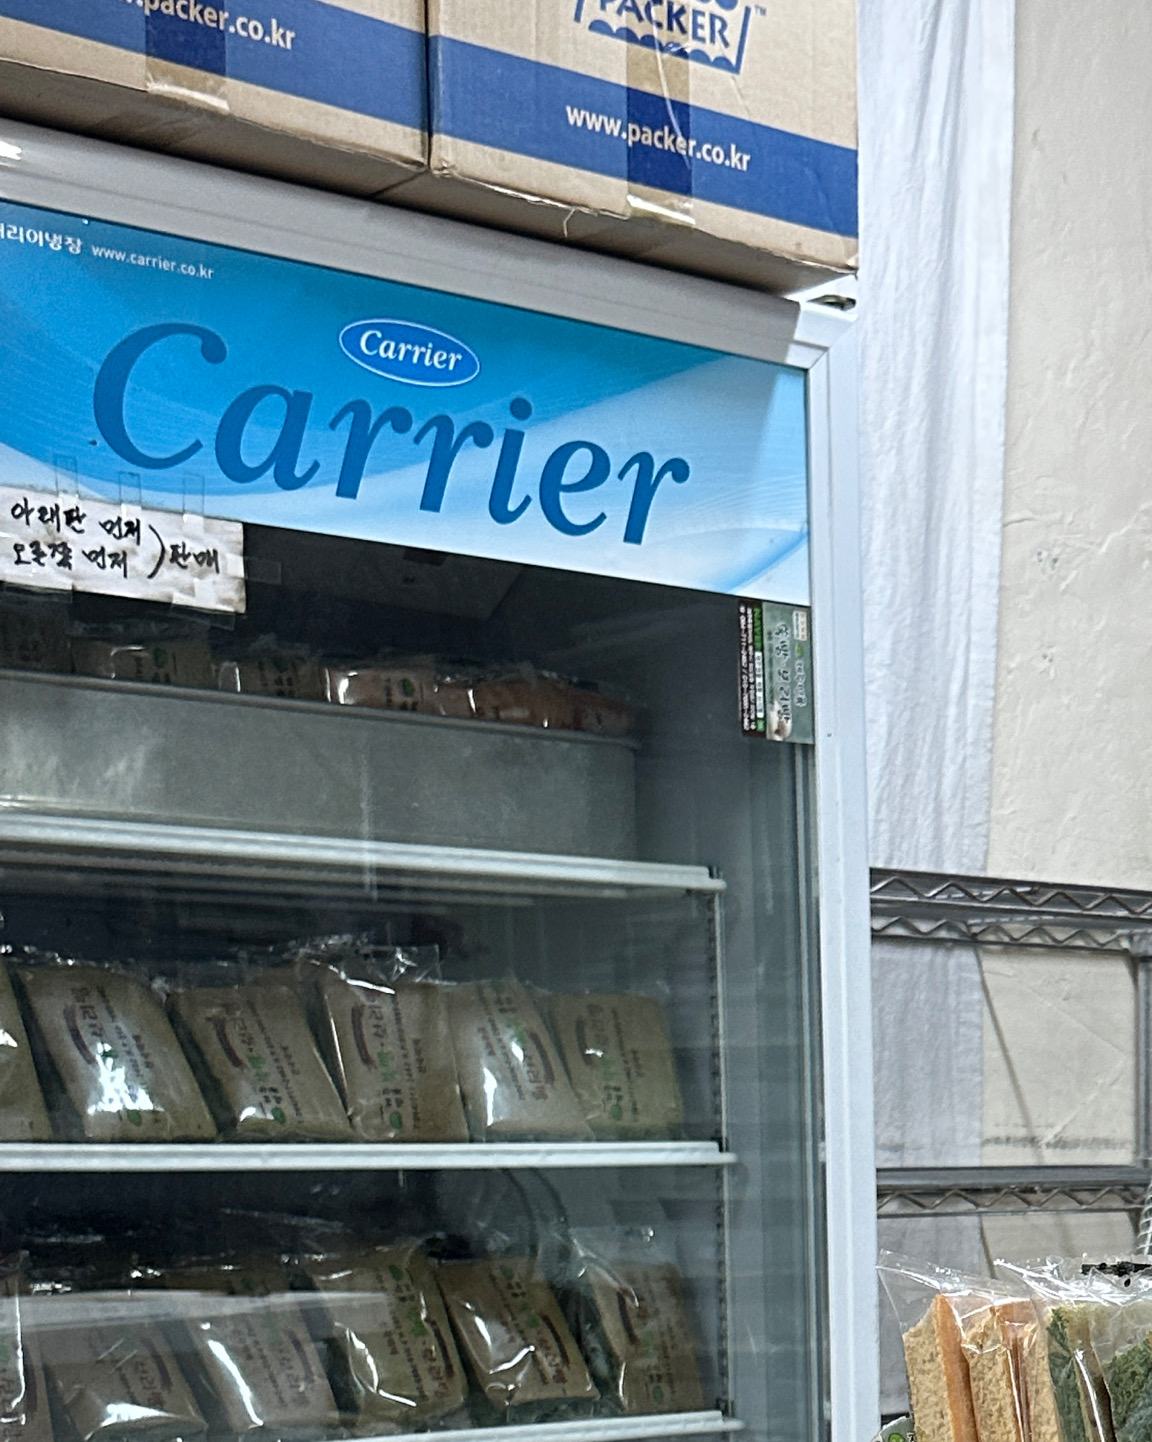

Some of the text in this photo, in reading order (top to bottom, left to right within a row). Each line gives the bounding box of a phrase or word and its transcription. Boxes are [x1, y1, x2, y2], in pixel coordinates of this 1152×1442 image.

[120, 0, 296, 50] .packer.co.kr
[565, 105, 751, 171] www.packer.co.kr
[91, 245, 214, 279] www.carrier.co.kr
[360, 330, 462, 371] Carrier
[93, 322, 692, 546] Carrier
